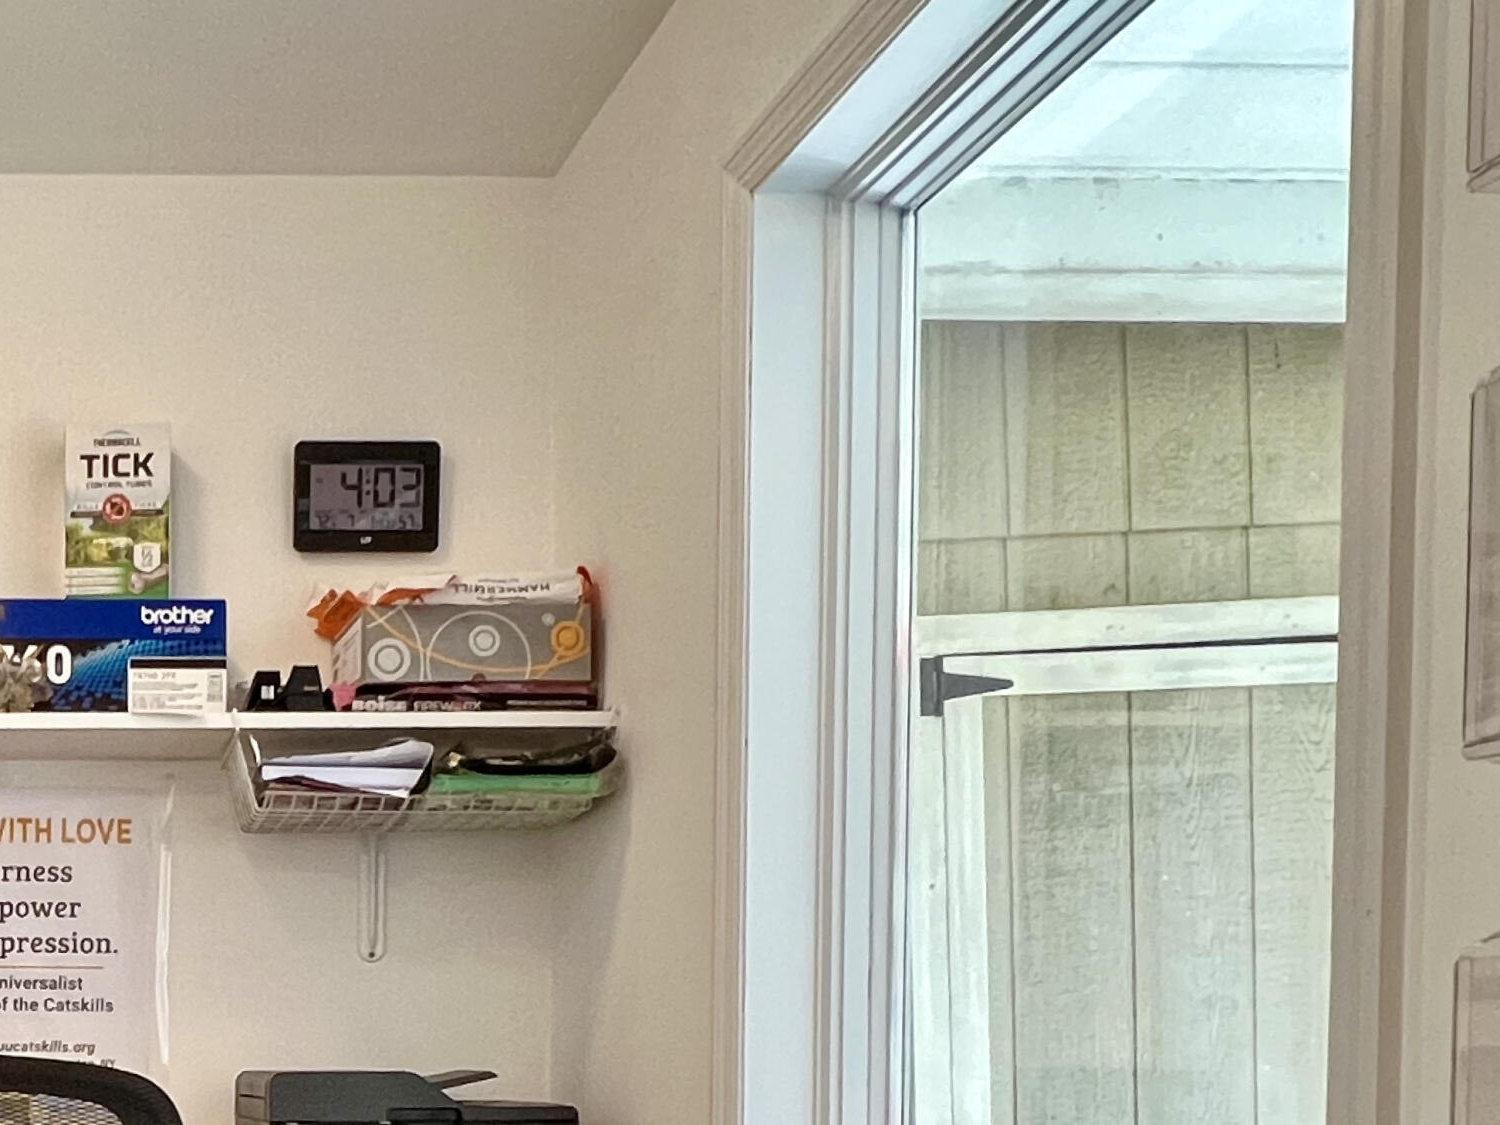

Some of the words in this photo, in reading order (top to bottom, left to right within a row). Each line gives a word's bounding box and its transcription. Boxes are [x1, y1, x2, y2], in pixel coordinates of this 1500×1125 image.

[80, 452, 154, 478] TICK
[341, 467, 422, 509] 4:03
[141, 605, 214, 625] brother
[164, 626, 182, 635] your
[184, 625, 201, 633] side
[61, 818, 132, 845] LOVE
[13, 998, 39, 1012] the
[44, 998, 114, 1013] Catskills
